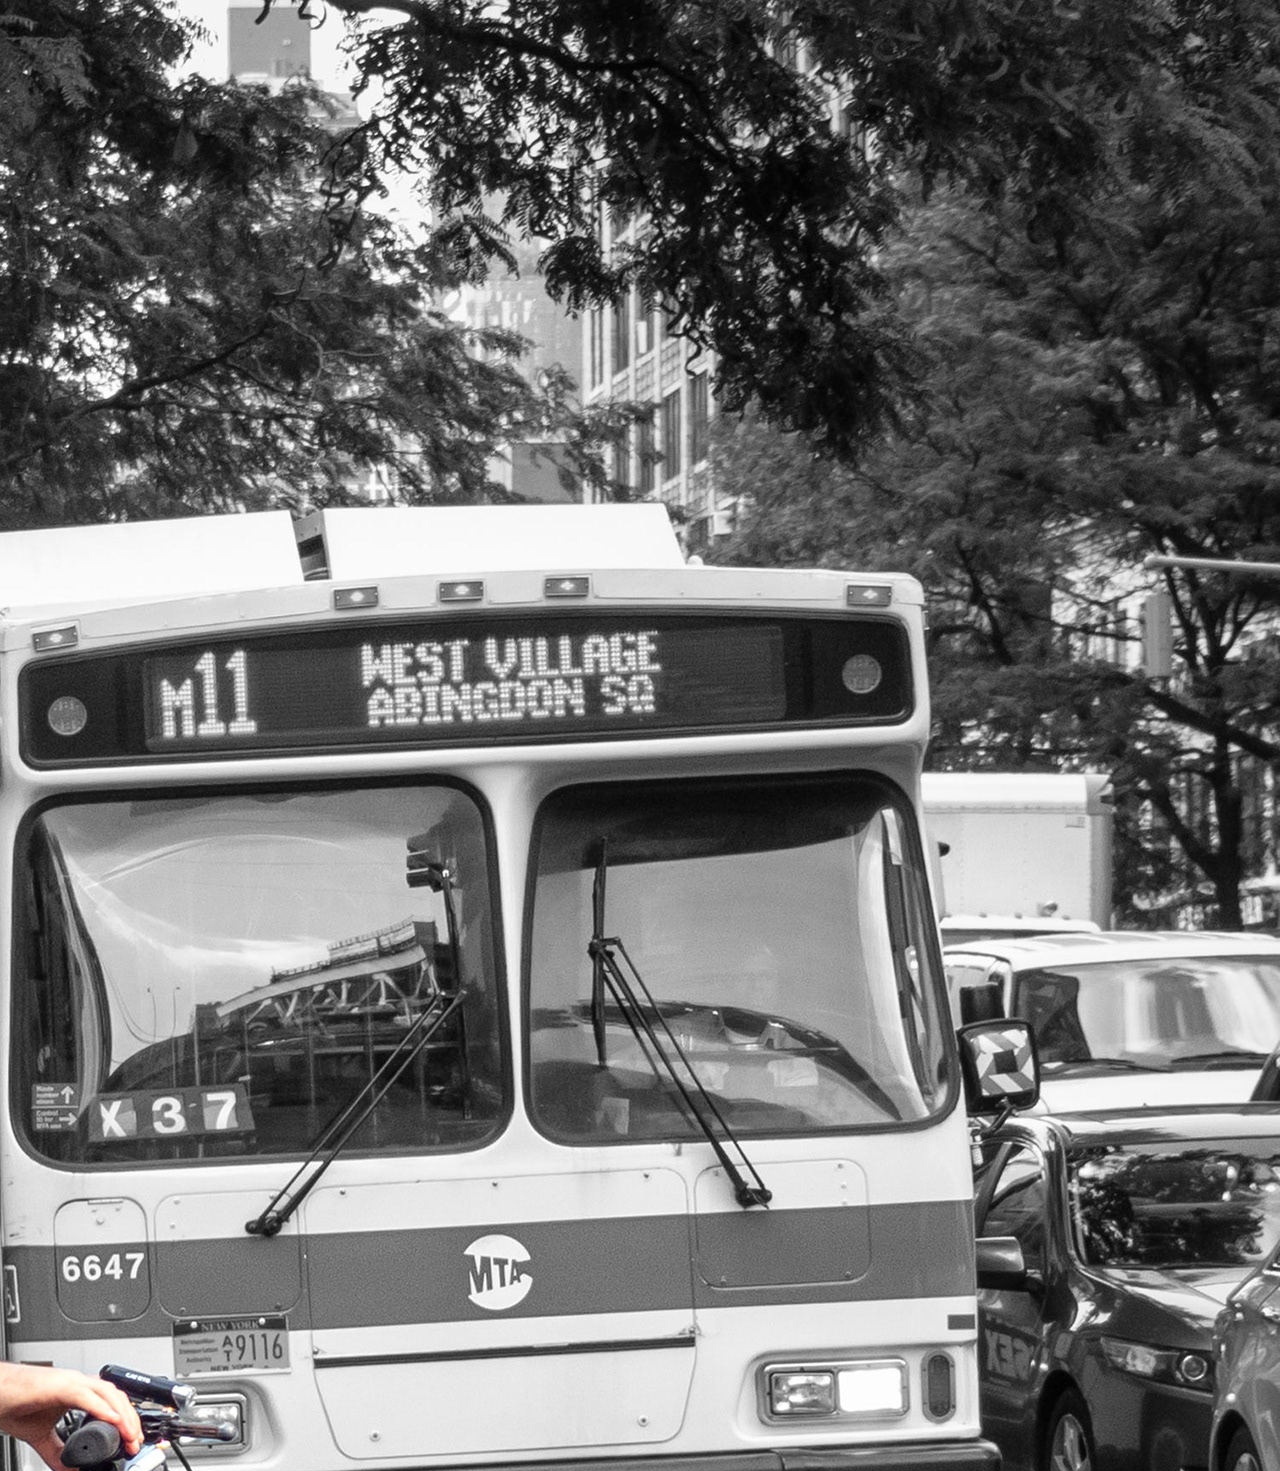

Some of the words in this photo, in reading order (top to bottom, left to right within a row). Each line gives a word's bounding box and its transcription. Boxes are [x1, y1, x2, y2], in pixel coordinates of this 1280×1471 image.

[360, 638, 470, 688] WEST
[485, 630, 662, 678] VILLAGE
[159, 650, 258, 738] M11
[366, 676, 585, 728] ABINGDON
[100, 1100, 128, 1138] X
[151, 1096, 186, 1134] 3
[206, 1091, 237, 1130] 7
[62, 1252, 145, 1282] 6647
[202, 1321, 229, 1331] NEW
[231, 1320, 260, 1330] YORK
[235, 1333, 283, 1361] 9116
